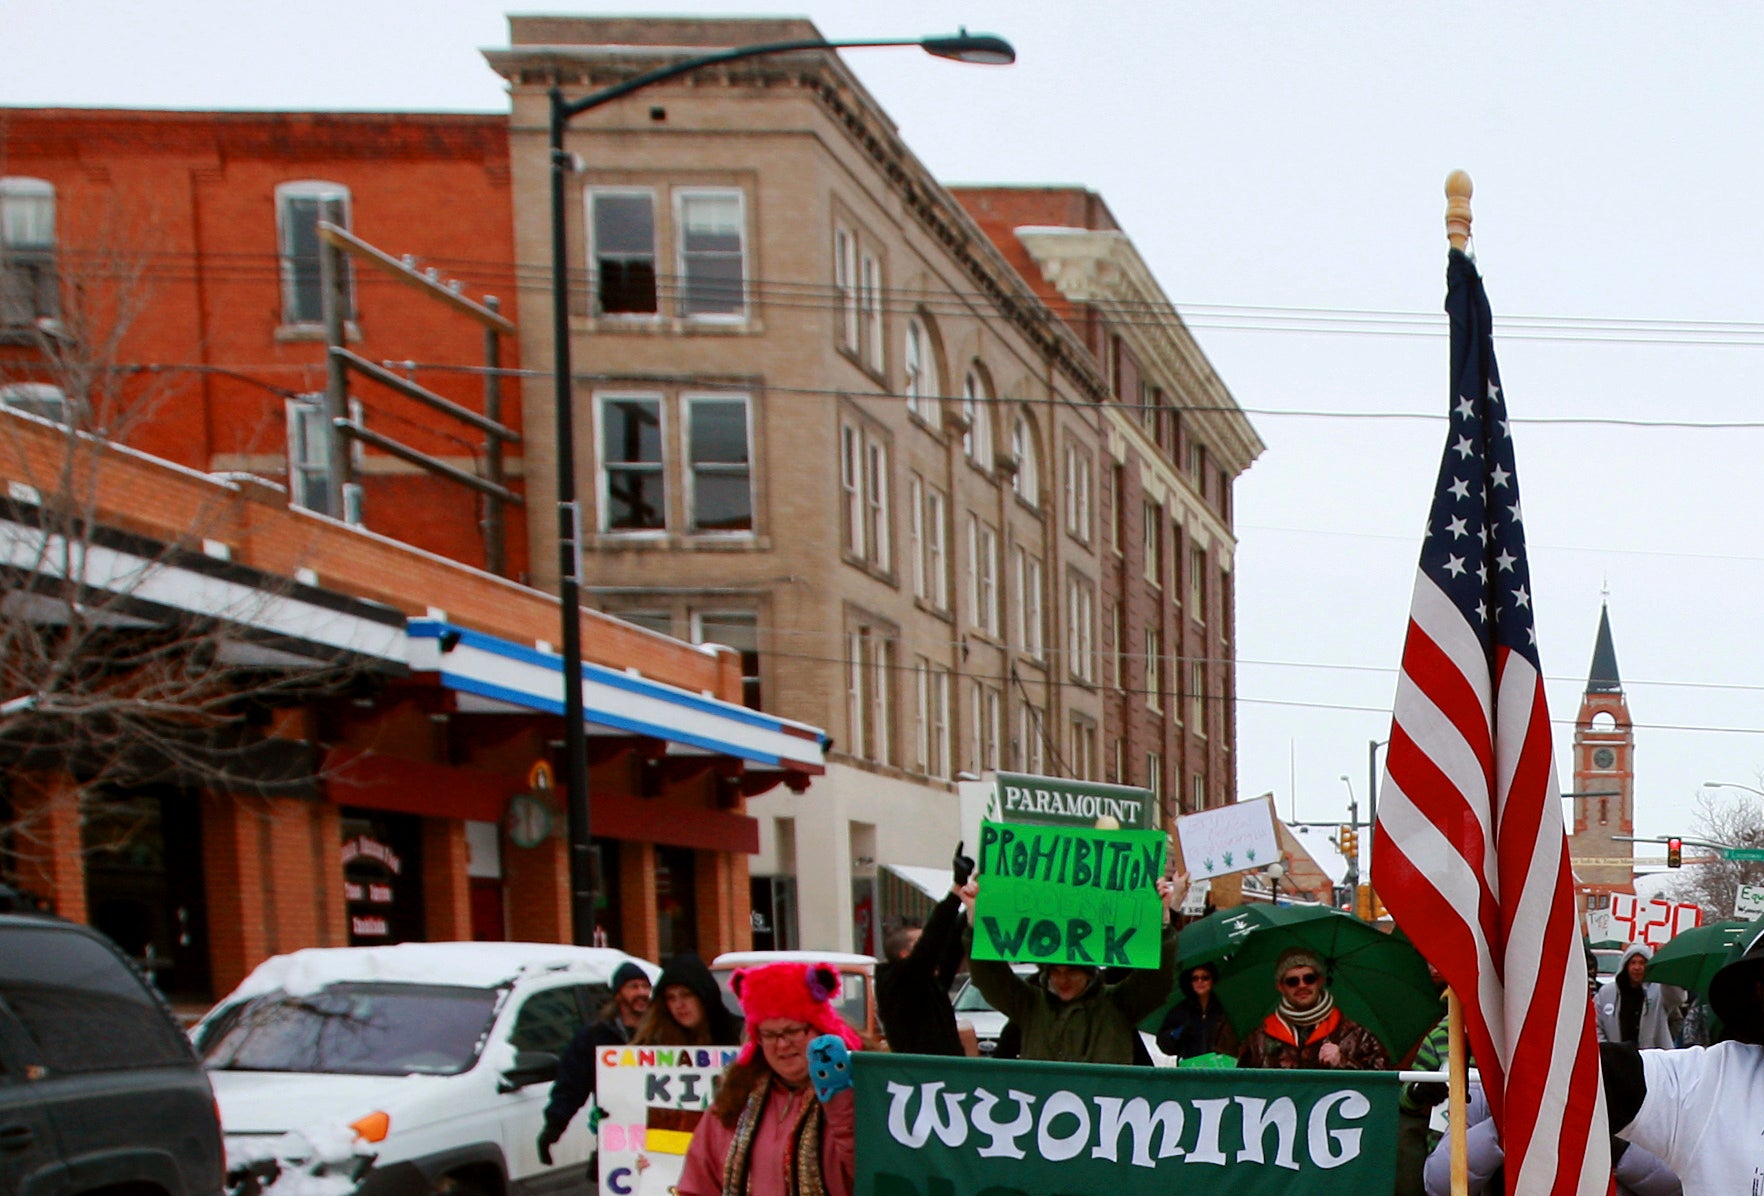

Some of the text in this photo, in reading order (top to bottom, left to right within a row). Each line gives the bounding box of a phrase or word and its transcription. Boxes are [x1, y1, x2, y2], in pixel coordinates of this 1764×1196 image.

[1005, 785, 1142, 824] PARAMOUNT
[978, 825, 1163, 893] PROHIBITION
[980, 916, 1137, 966] WORK
[886, 1080, 1371, 1170] WYOMING
